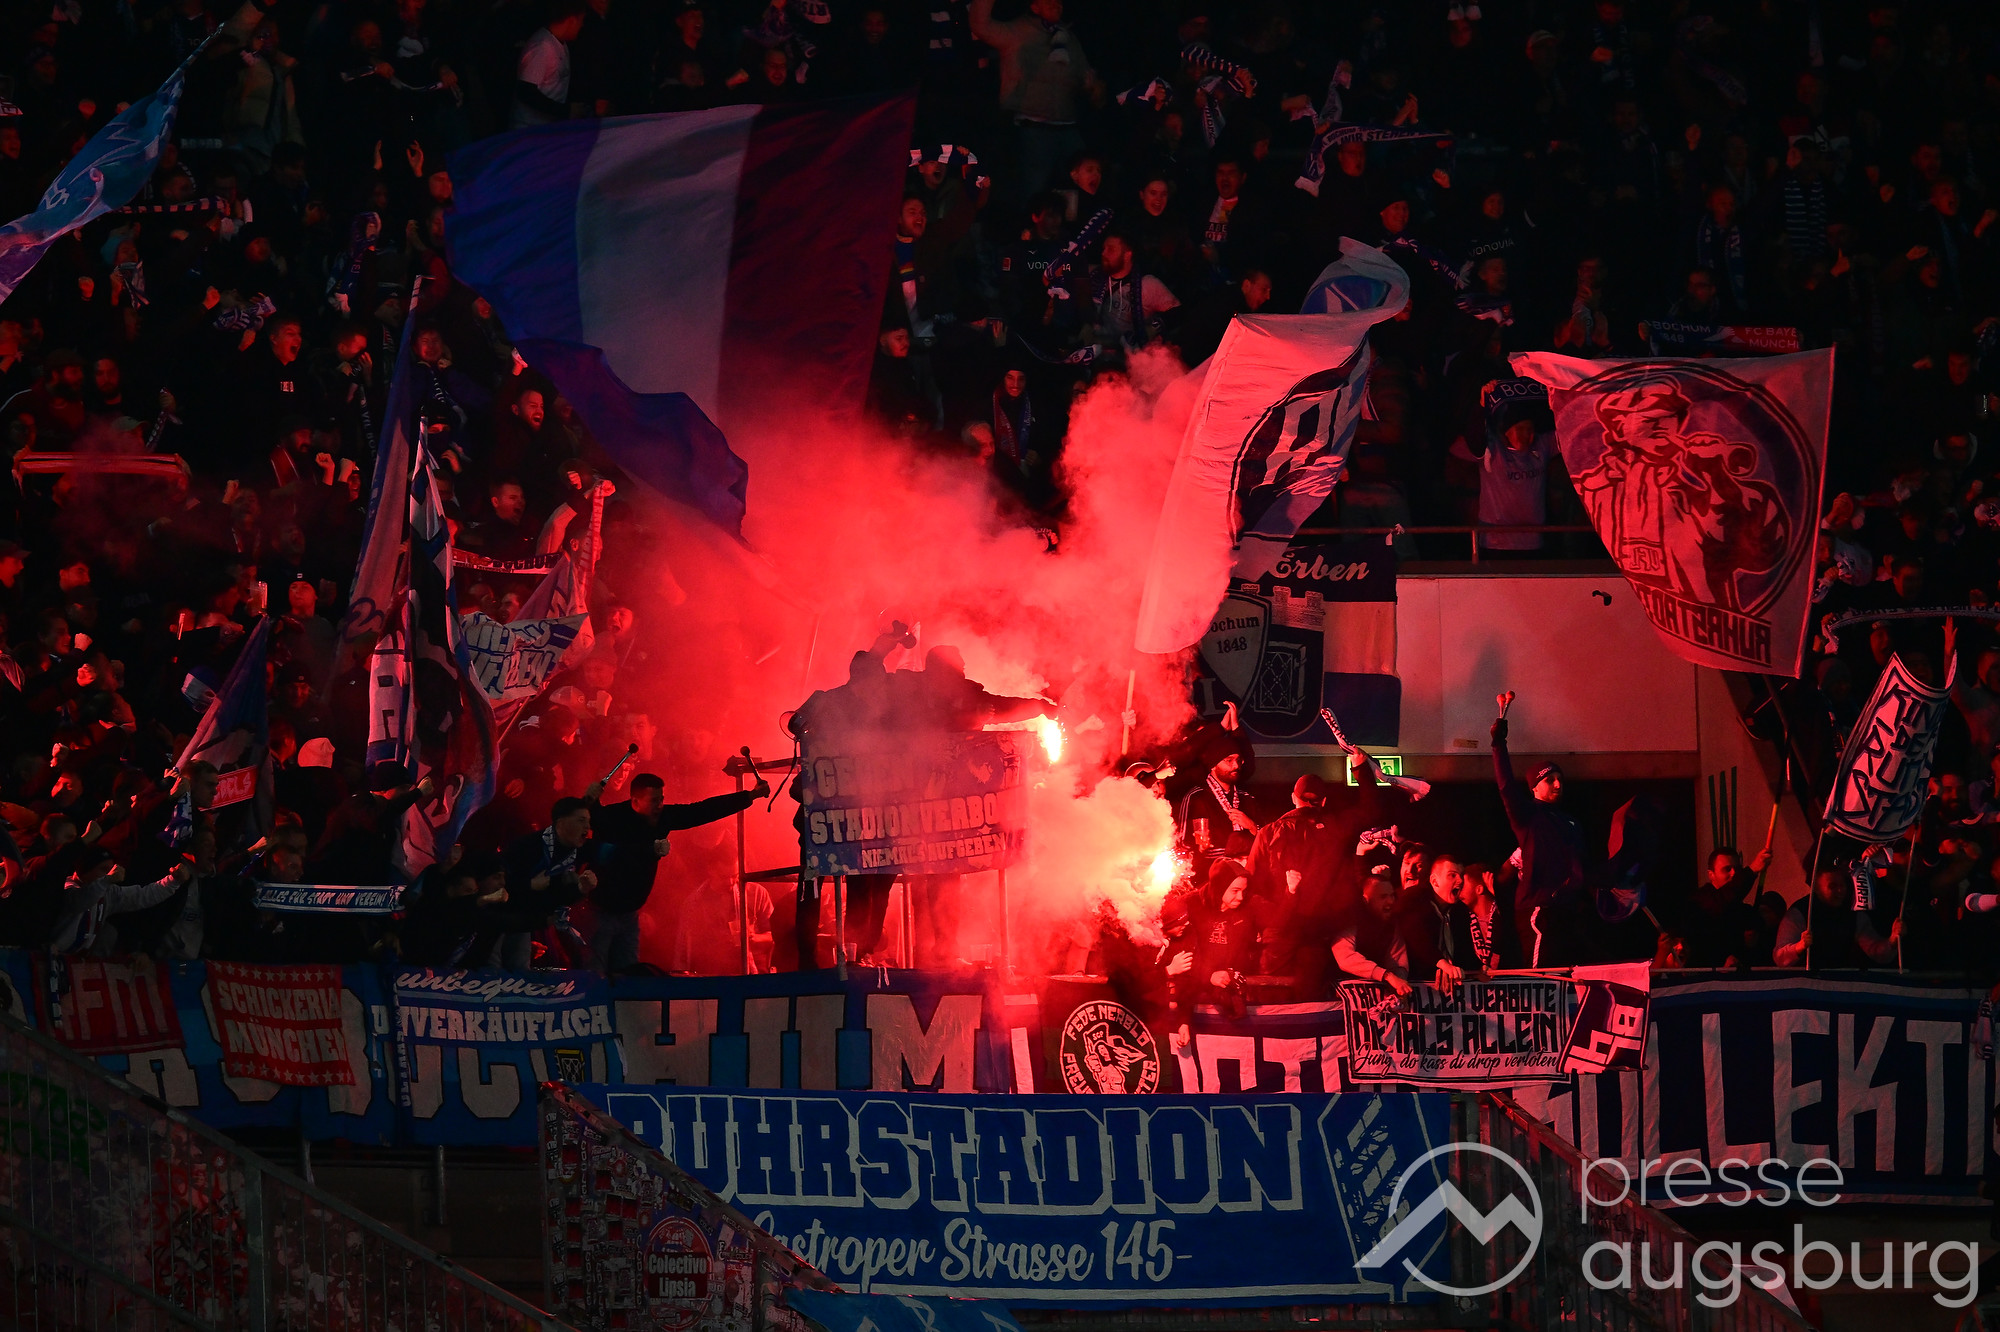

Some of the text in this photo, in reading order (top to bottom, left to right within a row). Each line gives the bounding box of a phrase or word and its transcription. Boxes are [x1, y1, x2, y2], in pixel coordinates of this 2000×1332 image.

[1275, 552, 1370, 581] Erben
[1209, 615, 1260, 633] ochum
[1216, 636, 1248, 653] 1848
[262, 888, 290, 903] ALLES
[288, 889, 307, 904] FÜR
[334, 892, 355, 906] UND
[1463, 1014, 1559, 1054] ALLEIN
[1400, 1050, 1419, 1068] do
[940, 1217, 1095, 1284] Strasse
[658, 1277, 697, 1299] Lipsia
